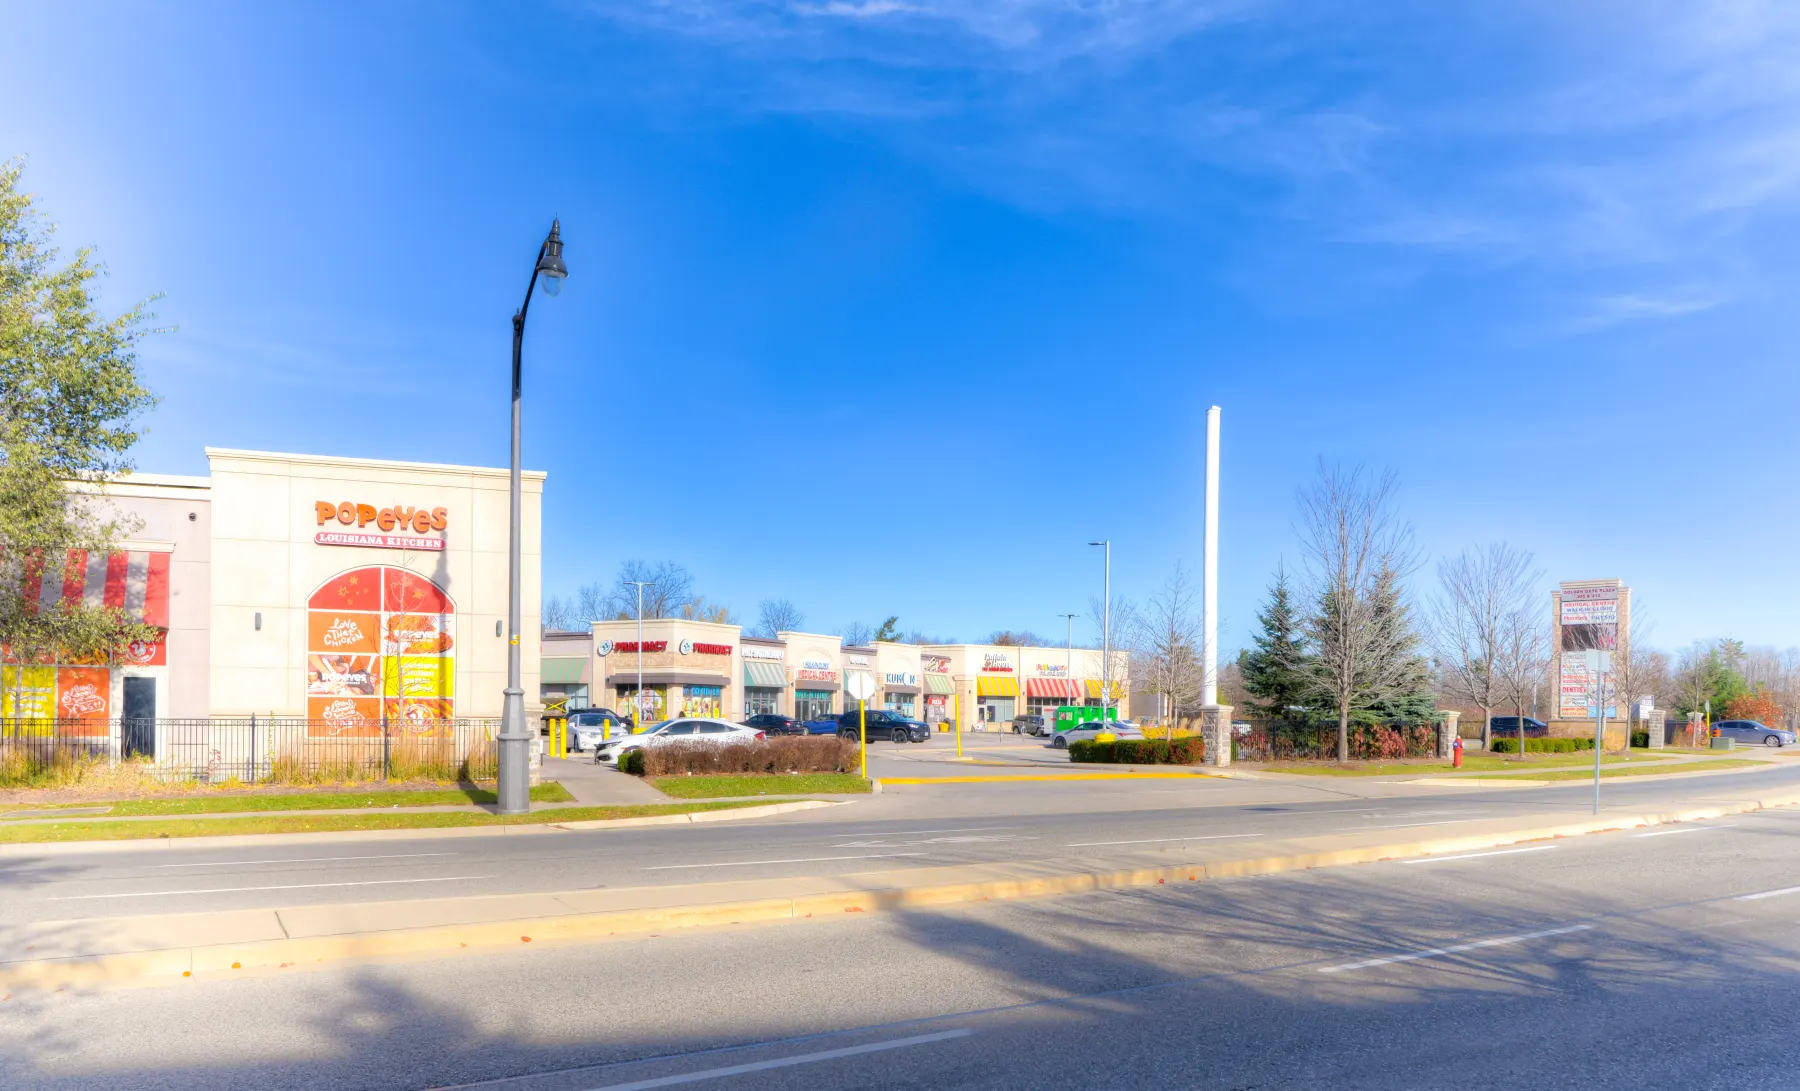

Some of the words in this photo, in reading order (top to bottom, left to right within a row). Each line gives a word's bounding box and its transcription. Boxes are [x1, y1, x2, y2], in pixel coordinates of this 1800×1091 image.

[319, 533, 383, 545] LOUISIANA
[386, 537, 441, 548] KITCHEN
[614, 641, 668, 653] PHARMACY
[693, 643, 733, 656] PHARMACY
[819, 671, 836, 681] CENTRE
